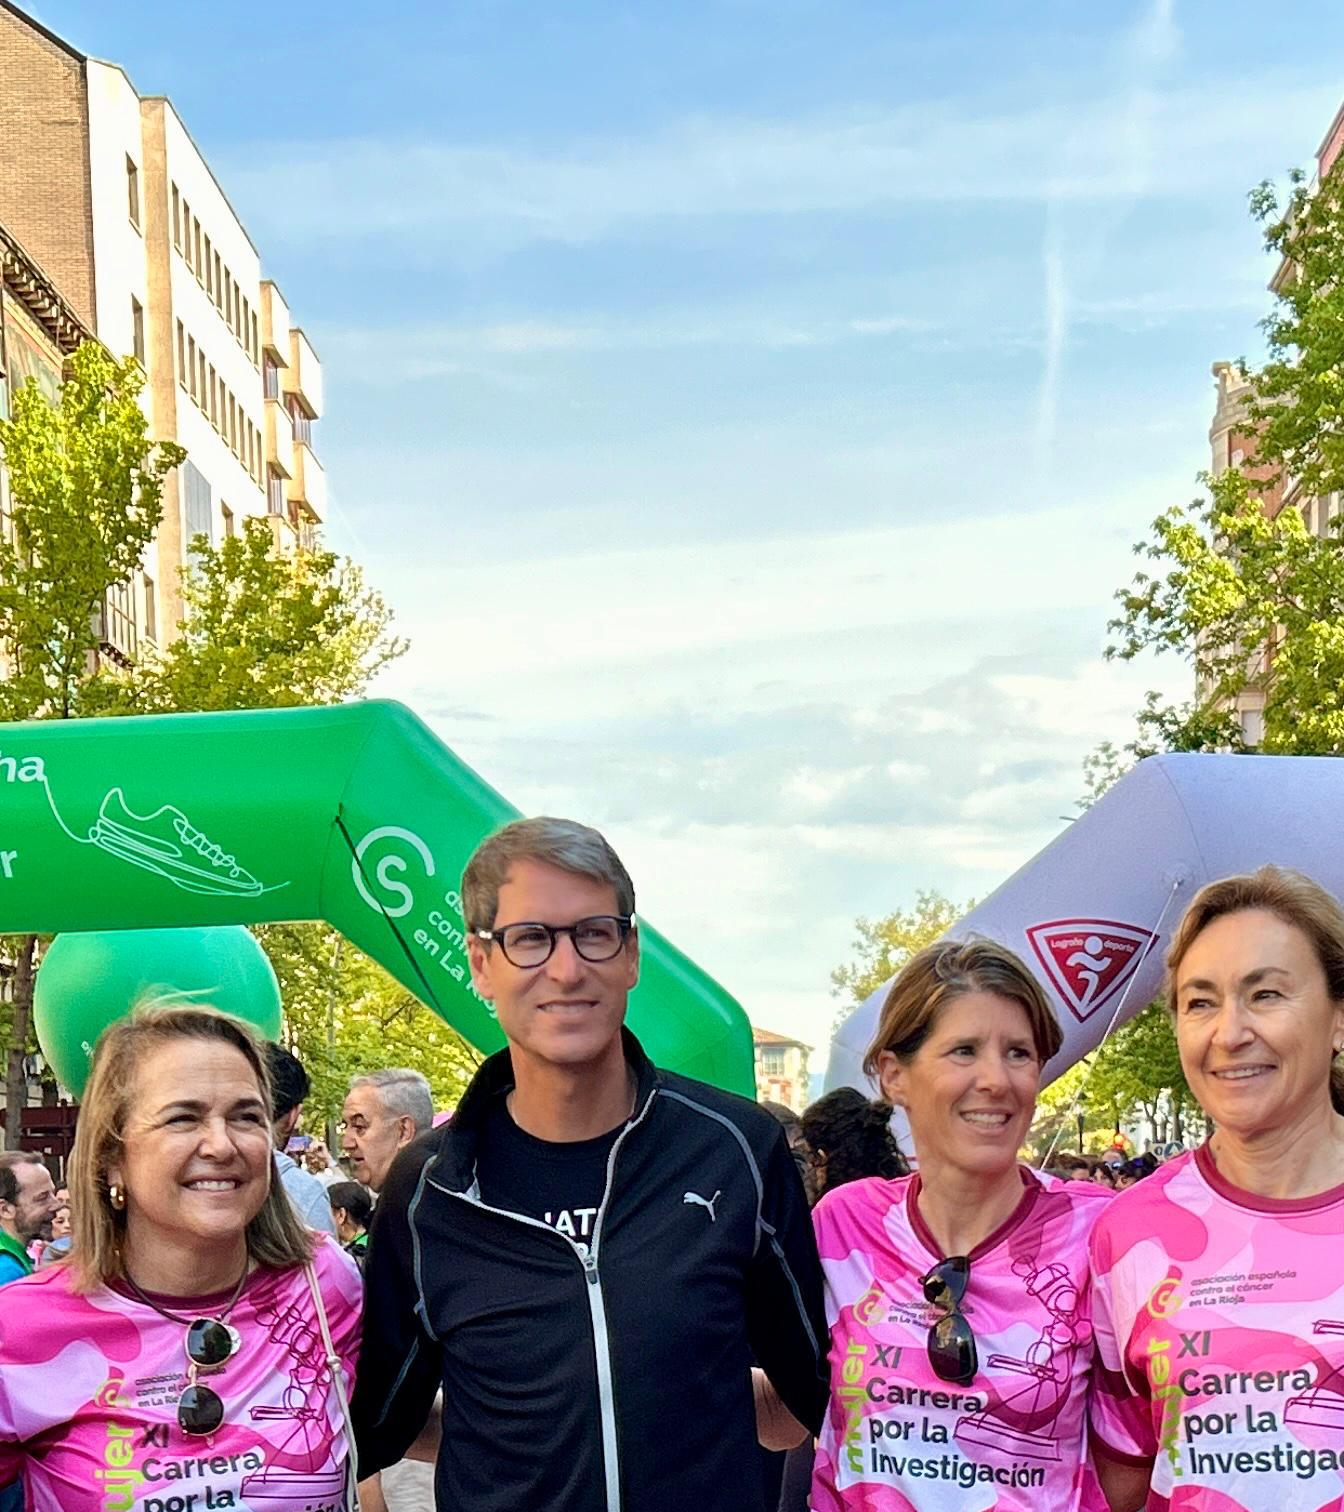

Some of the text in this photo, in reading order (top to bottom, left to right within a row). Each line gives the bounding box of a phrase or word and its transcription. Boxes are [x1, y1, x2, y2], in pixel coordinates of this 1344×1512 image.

[413, 928, 465, 982] en La
[1189, 1285, 1224, 1297] contra
[1236, 1281, 1274, 1293] cáncer
[1247, 1269, 1298, 1282] española
[1188, 1294, 1246, 1308] en La Rioja
[869, 1344, 903, 1369] XI
[1176, 1330, 1212, 1359] XI
[865, 1376, 984, 1414] Carrera
[1177, 1366, 1315, 1397] Carrera
[140, 1423, 170, 1449] XI
[868, 1416, 949, 1444] por la
[1183, 1404, 1278, 1444] por la
[140, 1451, 264, 1482] Carrera
[870, 1447, 1046, 1489] Investigación
[205, 1485, 235, 1510] la
